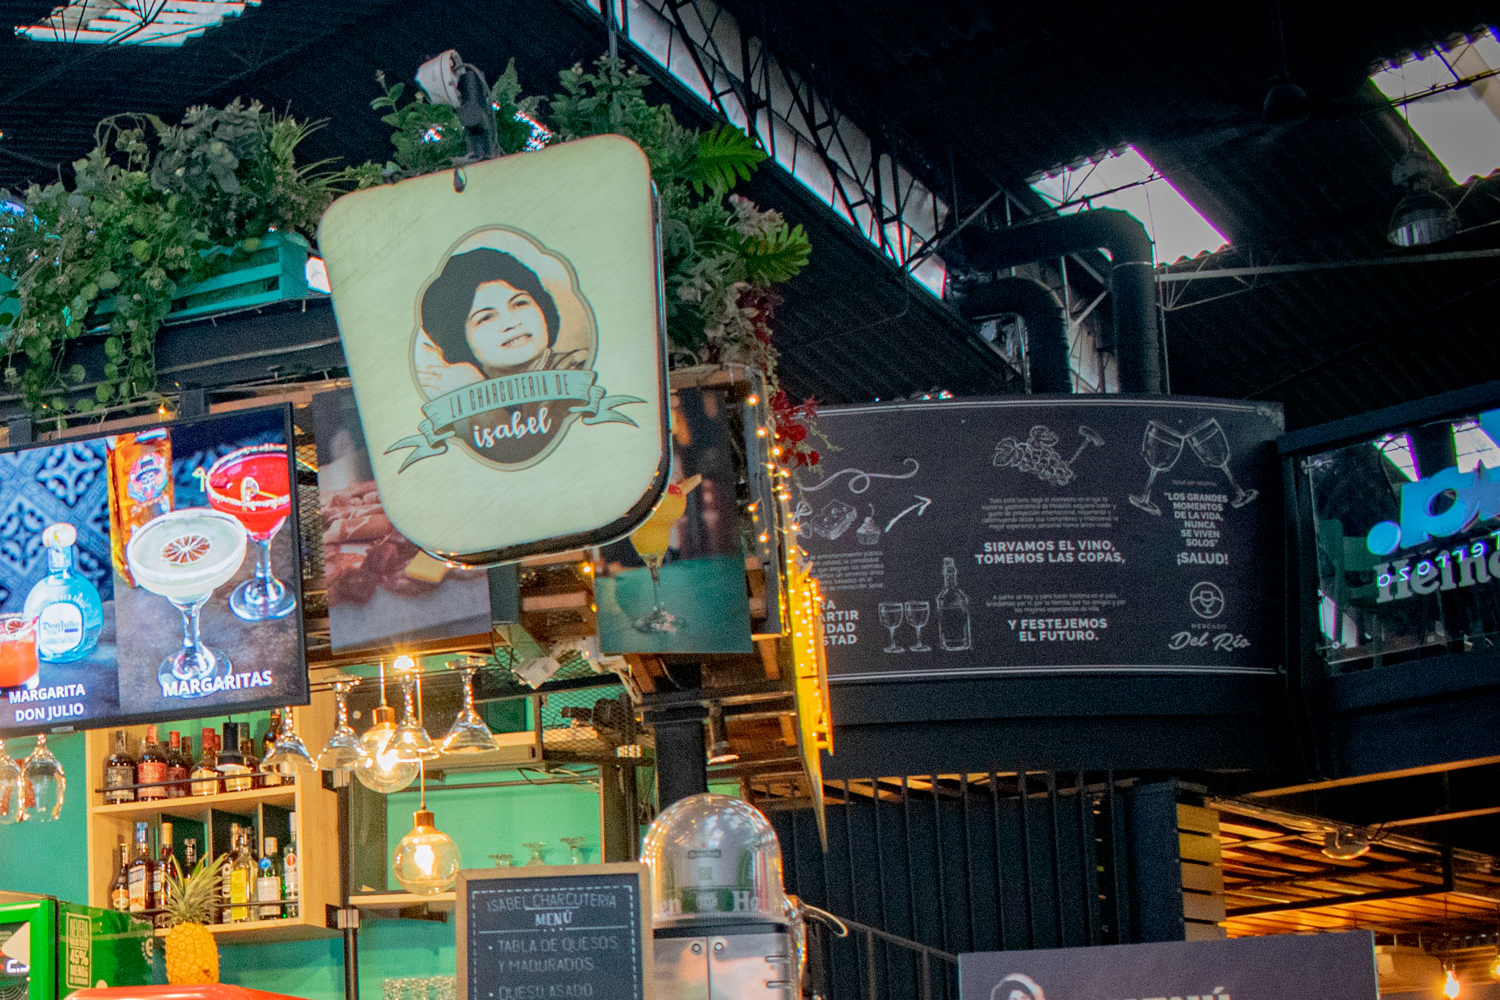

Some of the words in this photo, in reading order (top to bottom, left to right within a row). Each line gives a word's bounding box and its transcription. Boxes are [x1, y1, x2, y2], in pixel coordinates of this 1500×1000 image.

[451, 394, 463, 418] LA
[555, 374, 569, 396] DE
[473, 406, 551, 448] isabel
[1187, 493, 1228, 503] GRANDES
[1173, 502, 1224, 512] MOMENTOS
[1174, 511, 1187, 519] DE
[1188, 511, 1200, 519] LA
[1184, 520, 1216, 529] NUNCA
[1181, 529, 1193, 538] SE
[1194, 529, 1220, 538] VIVEN
[983, 540, 1055, 552] SIRVAMOS
[1058, 540, 1075, 551] EL
[1077, 540, 1116, 552] VINO,
[975, 553, 1045, 565] TOMEMOS
[1048, 552, 1074, 563] LAS
[1077, 552, 1126, 564] COPAS,
[1177, 552, 1229, 565] ¡SALUD!
[1008, 619, 1017, 629] Y
[1020, 618, 1108, 629] FESTEJEMOS
[1019, 631, 1035, 641] EL
[1039, 631, 1099, 641] FUTURO.
[1168, 632, 1209, 650] Del
[162, 670, 273, 698] MARGARITAS
[8, 683, 86, 704] MARGARITA
[15, 708, 45, 722] DON
[47, 703, 84, 721] JULIO
[487, 894, 525, 912] ISABEL
[535, 909, 573, 926] MENÚ
[498, 939, 536, 953] TABLA
[540, 938, 558, 951] DE
[562, 935, 618, 952] QUESOS
[70, 949, 89, 966] 45%
[499, 960, 507, 973] Y
[509, 957, 594, 973] MADURADOS
[550, 983, 592, 999] ASADO
